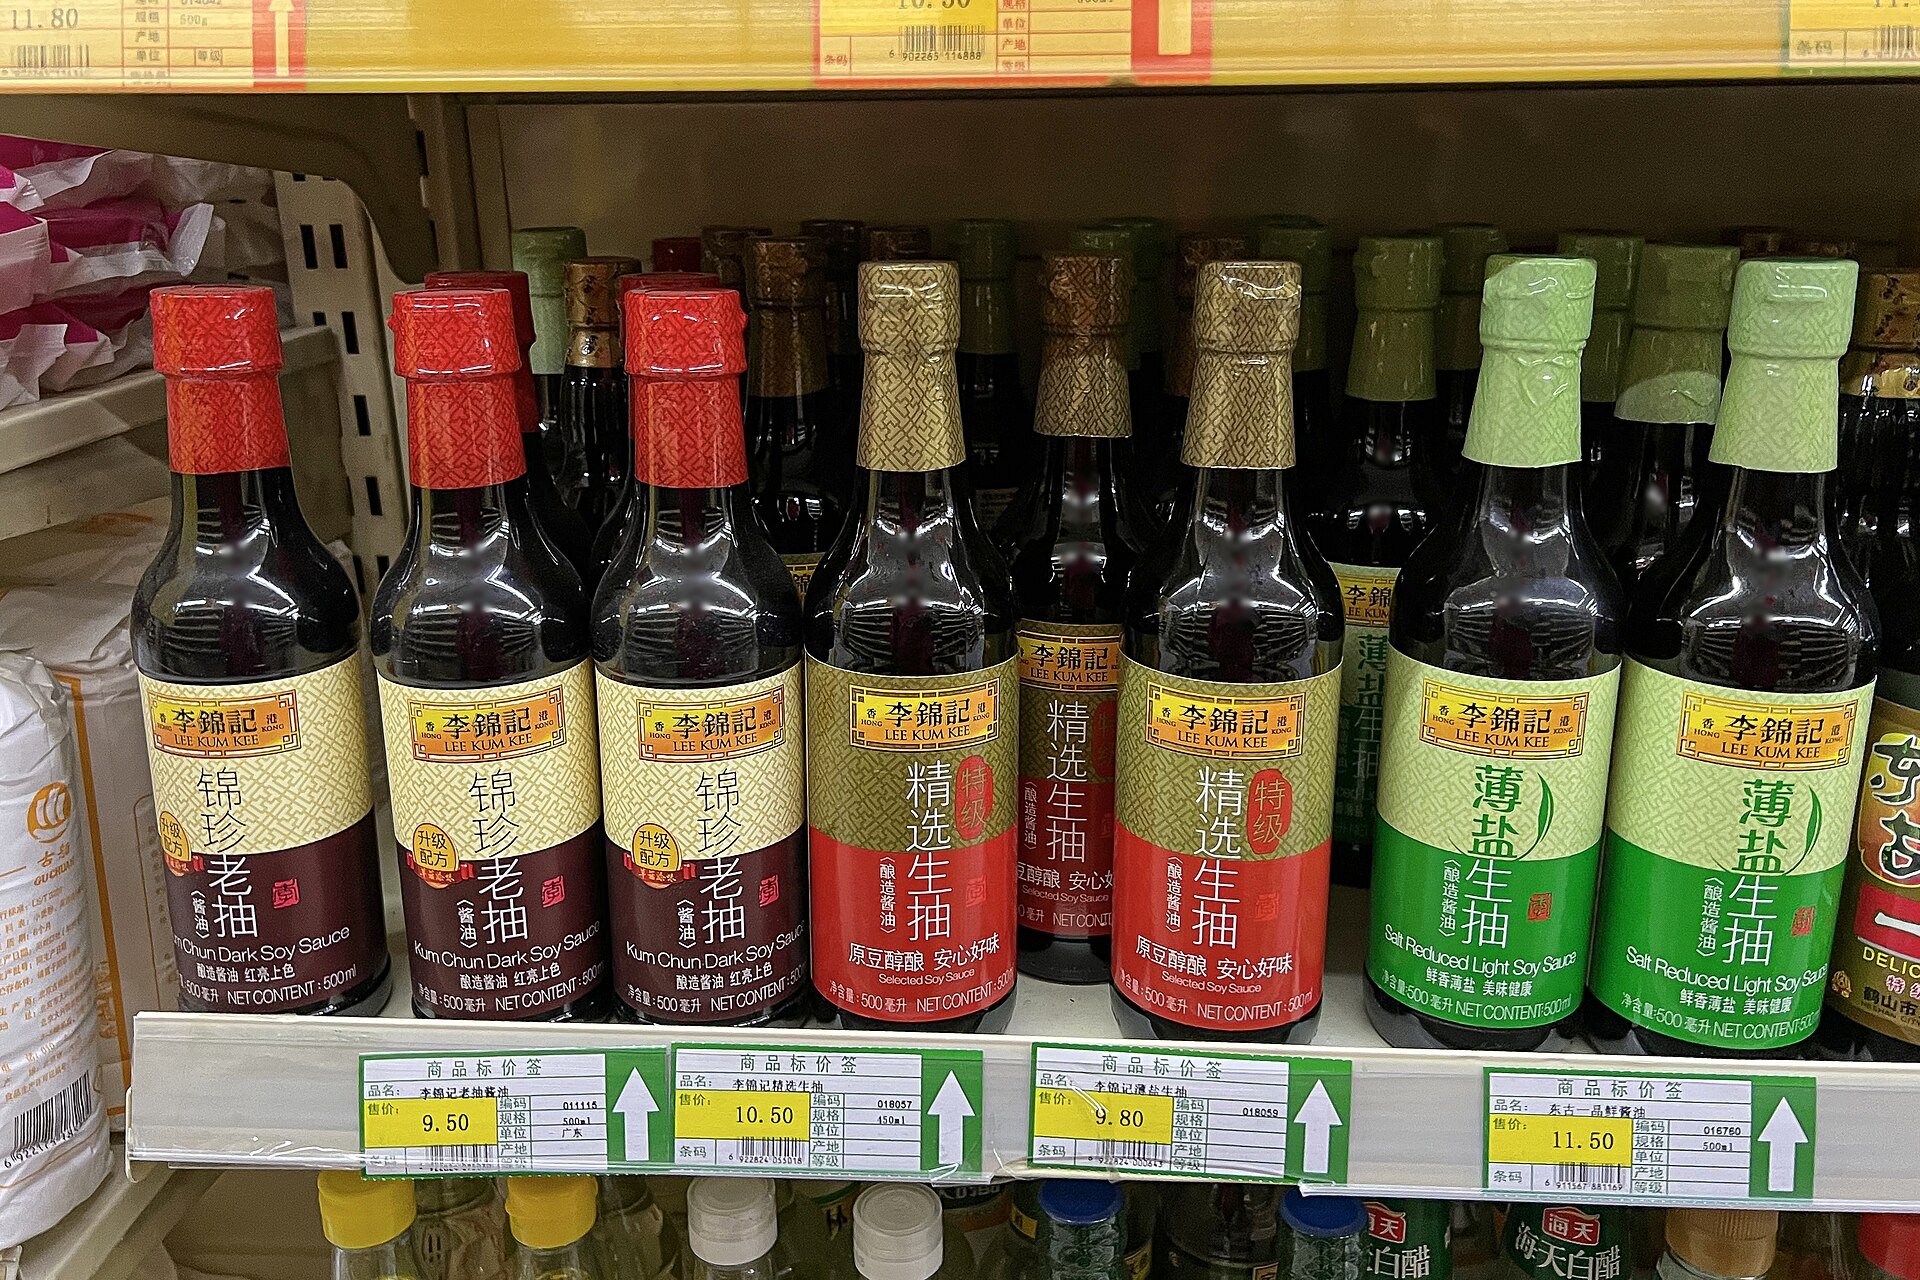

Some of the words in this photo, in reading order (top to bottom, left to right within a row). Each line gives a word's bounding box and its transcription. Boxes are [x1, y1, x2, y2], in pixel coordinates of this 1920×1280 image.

[12, 8, 79, 30] 11.80
[1002, 39, 1026, 51] 产地
[1031, 643, 1109, 670] 李錦記
[1030, 668, 1049, 680] LEE
[1053, 670, 1083, 683] KUM
[1086, 671, 1108, 683] KEE
[171, 708, 258, 735] 李錦記
[672, 706, 757, 739] 李錦記
[885, 698, 971, 727] 李錦記
[1178, 704, 1270, 735] 李錦記
[1457, 702, 1553, 734] 李錦記
[442, 707, 531, 739] 李錦記
[885, 728, 909, 741] LEE
[912, 726, 945, 740] KUM
[948, 724, 970, 737] KEE
[1723, 713, 1825, 746] 李錦記
[174, 734, 194, 747] LEE
[198, 735, 230, 747] KUM
[233, 733, 259, 746] KEE
[444, 740, 468, 753] LEE
[471, 738, 506, 752] KUM
[508, 732, 533, 746] KEE
[673, 739, 695, 753] LEE
[701, 739, 731, 752] KUM
[735, 732, 758, 747] KEE
[1177, 728, 1200, 745] LEE
[1204, 733, 1239, 747] KUM
[1243, 735, 1268, 748] KEE
[1455, 727, 1482, 743] LEE
[1484, 733, 1520, 747] KUM
[1524, 735, 1550, 748] KEE
[1721, 740, 1749, 756] LEE
[1754, 744, 1791, 758] KUM
[1795, 744, 1821, 759] KEE
[1047, 699, 1089, 864] 精选生抽
[959, 763, 988, 832] 特级
[1251, 780, 1285, 843] 特级
[417, 829, 446, 851] 升级
[638, 829, 670, 850] 升级
[196, 766, 259, 938] 锦珍老抽
[419, 848, 448, 869] 配方
[469, 769, 529, 945] 锦珍老抽
[639, 848, 670, 869] 配方
[695, 768, 747, 945] 锦珍老抽
[905, 759, 952, 942] 精选生抽
[1192, 765, 1246, 950] 精选生抽
[180, 936, 216, 961] Chun
[218, 943, 259, 963] Dark
[261, 943, 297, 961] Soy
[298, 925, 351, 952] Sauce
[414, 941, 438, 964] Kum
[442, 951, 485, 969] Chun
[487, 950, 528, 969] Dark
[529, 939, 562, 964] Soy
[848, 941, 925, 973] 原豆醇酿
[933, 931, 1000, 972] 安心好味
[1385, 923, 1404, 949] Salt
[1406, 935, 1469, 970] Reduced
[1472, 955, 1510, 979] Light
[1511, 960, 1540, 977] Soy
[1543, 949, 1577, 975] Sauce
[626, 940, 655, 964] Kum
[657, 951, 701, 970] Chun
[704, 949, 744, 970] Dark
[745, 940, 775, 964] Soy
[1135, 934, 1207, 978] 原豆醇酿
[1216, 952, 1293, 981] 安心好味
[244, 963, 296, 983] 红亮上色
[513, 962, 562, 986] 红亮上色
[730, 962, 773, 987] 红亮上色
[879, 973, 924, 986] Selected
[925, 973, 944, 987] Soy
[945, 967, 975, 984] Sauce
[1626, 945, 1652, 972] Salt
[1655, 958, 1731, 990] Reduced
[1733, 973, 1772, 997] Light
[1774, 974, 1799, 993] Soy
[1161, 970, 1206, 993] Selected
[1206, 981, 1229, 996] Soy
[1228, 982, 1262, 994] Sauce
[1425, 966, 1475, 994] 鲜香薄盐
[1482, 978, 1533, 997] 美味健康
[1455, 999, 1481, 1019] NET
[1679, 988, 1737, 1014] 鲜香薄盐
[1742, 994, 1794, 1015] 美味健康
[427, 1058, 542, 1079] 商品标价签
[740, 1053, 857, 1075] 商品标价签
[1101, 1054, 1223, 1080] 商品标价签
[420, 1085, 509, 1100] 李锦记老抽酱油
[732, 1079, 824, 1093] 李锦记精选生抽
[1557, 1078, 1683, 1100] 商品标价签
[500, 1097, 527, 1110] 编码
[562, 1101, 597, 1110] 011115
[812, 1093, 841, 1107] 编码
[877, 1099, 912, 1109] 018057
[1176, 1097, 1204, 1112] 编码
[500, 1111, 526, 1125] 规格
[562, 1117, 591, 1126] 500ml
[735, 1105, 794, 1125] 10.50
[812, 1109, 841, 1122] 规格
[1095, 1108, 1144, 1128] 9.80
[1174, 1113, 1204, 1127] 规格
[1242, 1107, 1279, 1118] 018059
[422, 1113, 469, 1133] 9.50
[500, 1126, 527, 1140] 单位
[561, 1128, 583, 1138] 广东
[812, 1124, 840, 1137] 单位
[1635, 1119, 1665, 1133] 编码
[1174, 1127, 1203, 1142] 单位
[1552, 1131, 1615, 1151] 11.50
[1635, 1135, 1664, 1149] 规格
[500, 1142, 527, 1156] 产地
[680, 1145, 707, 1159] 条码
[812, 1140, 840, 1153] 产地
[1038, 1144, 1066, 1158] 条码
[1174, 1143, 1202, 1156] 产地
[1702, 1141, 1733, 1153] 500ml
[739, 1154, 769, 1164] 922824
[812, 1154, 839, 1168] 等级
[1173, 1158, 1201, 1172] 等级
[1634, 1151, 1663, 1164] 单位
[1493, 1170, 1522, 1184] 条码
[1633, 1167, 1663, 1179] 产地
[1556, 1181, 1588, 1191] 911567
[1633, 1181, 1663, 1194] 等级
[1550, 1213, 1594, 1242] 海天
[1515, 1221, 1620, 1280] 海天白醋
